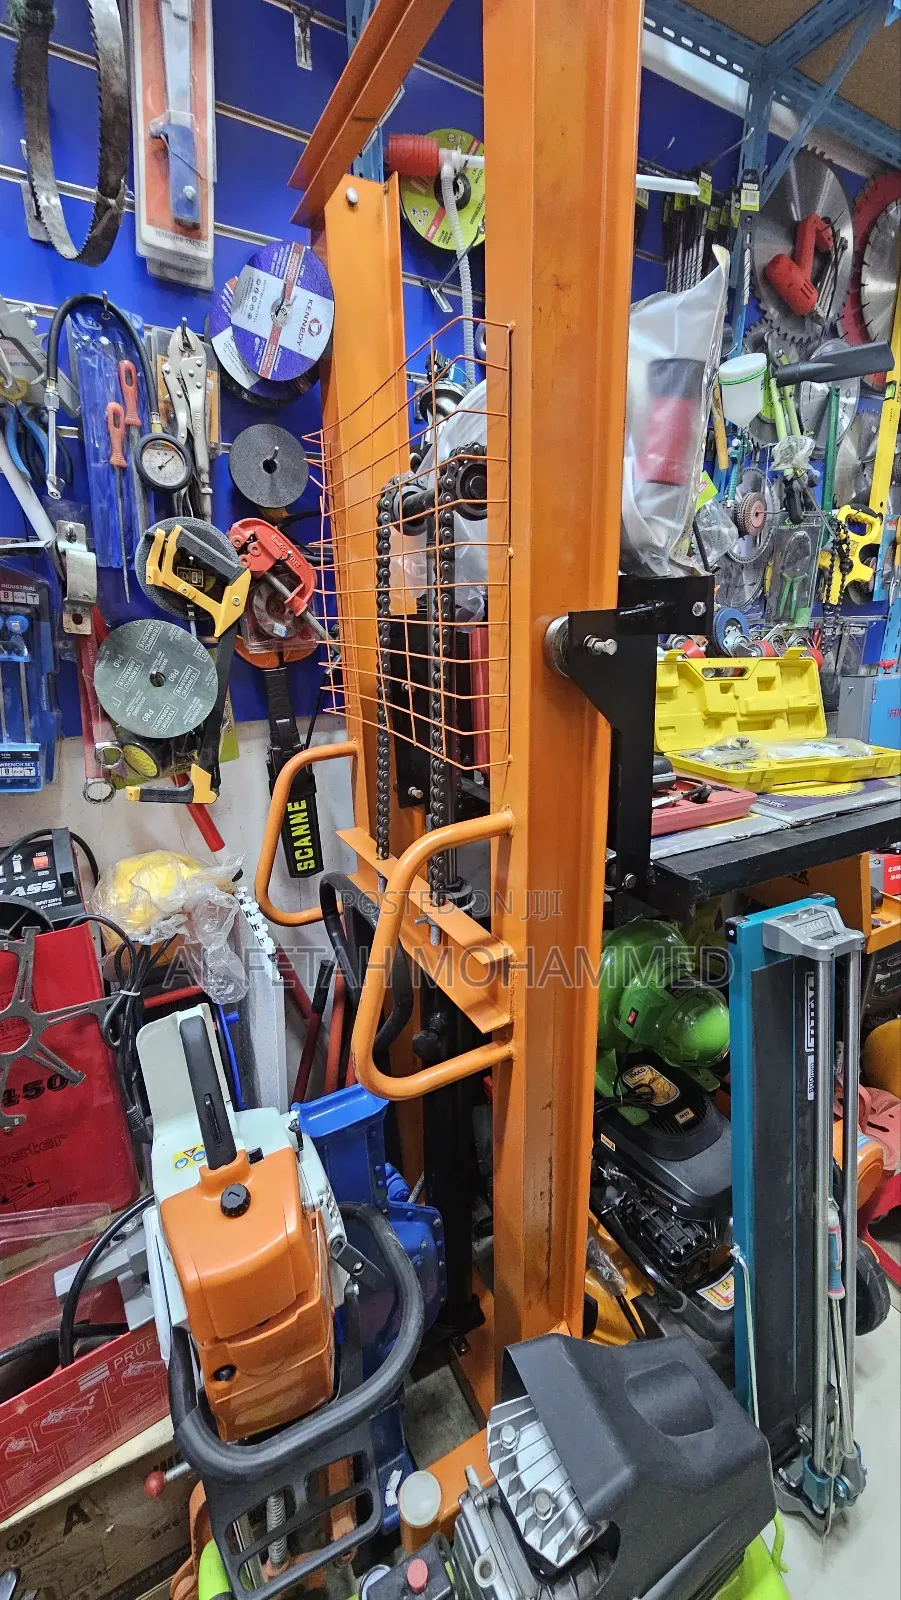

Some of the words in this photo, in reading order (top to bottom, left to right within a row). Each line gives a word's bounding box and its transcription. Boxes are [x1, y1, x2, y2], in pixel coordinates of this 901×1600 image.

[155, 230, 184, 242] HAMMER
[296, 298, 313, 348] KENNEDY
[145, 625, 161, 651] TERRIFIC
[113, 653, 124, 668] P80
[118, 659, 136, 687] ABRASIVE
[123, 663, 141, 689] TERRIFIC
[168, 668, 180, 682] P80
[175, 667, 193, 694] ABRASIVE
[180, 671, 198, 697] TERRIFIC
[141, 708, 154, 722] P80
[287, 800, 316, 872] SCANNE
[113, 1337, 157, 1370] PRÜF
